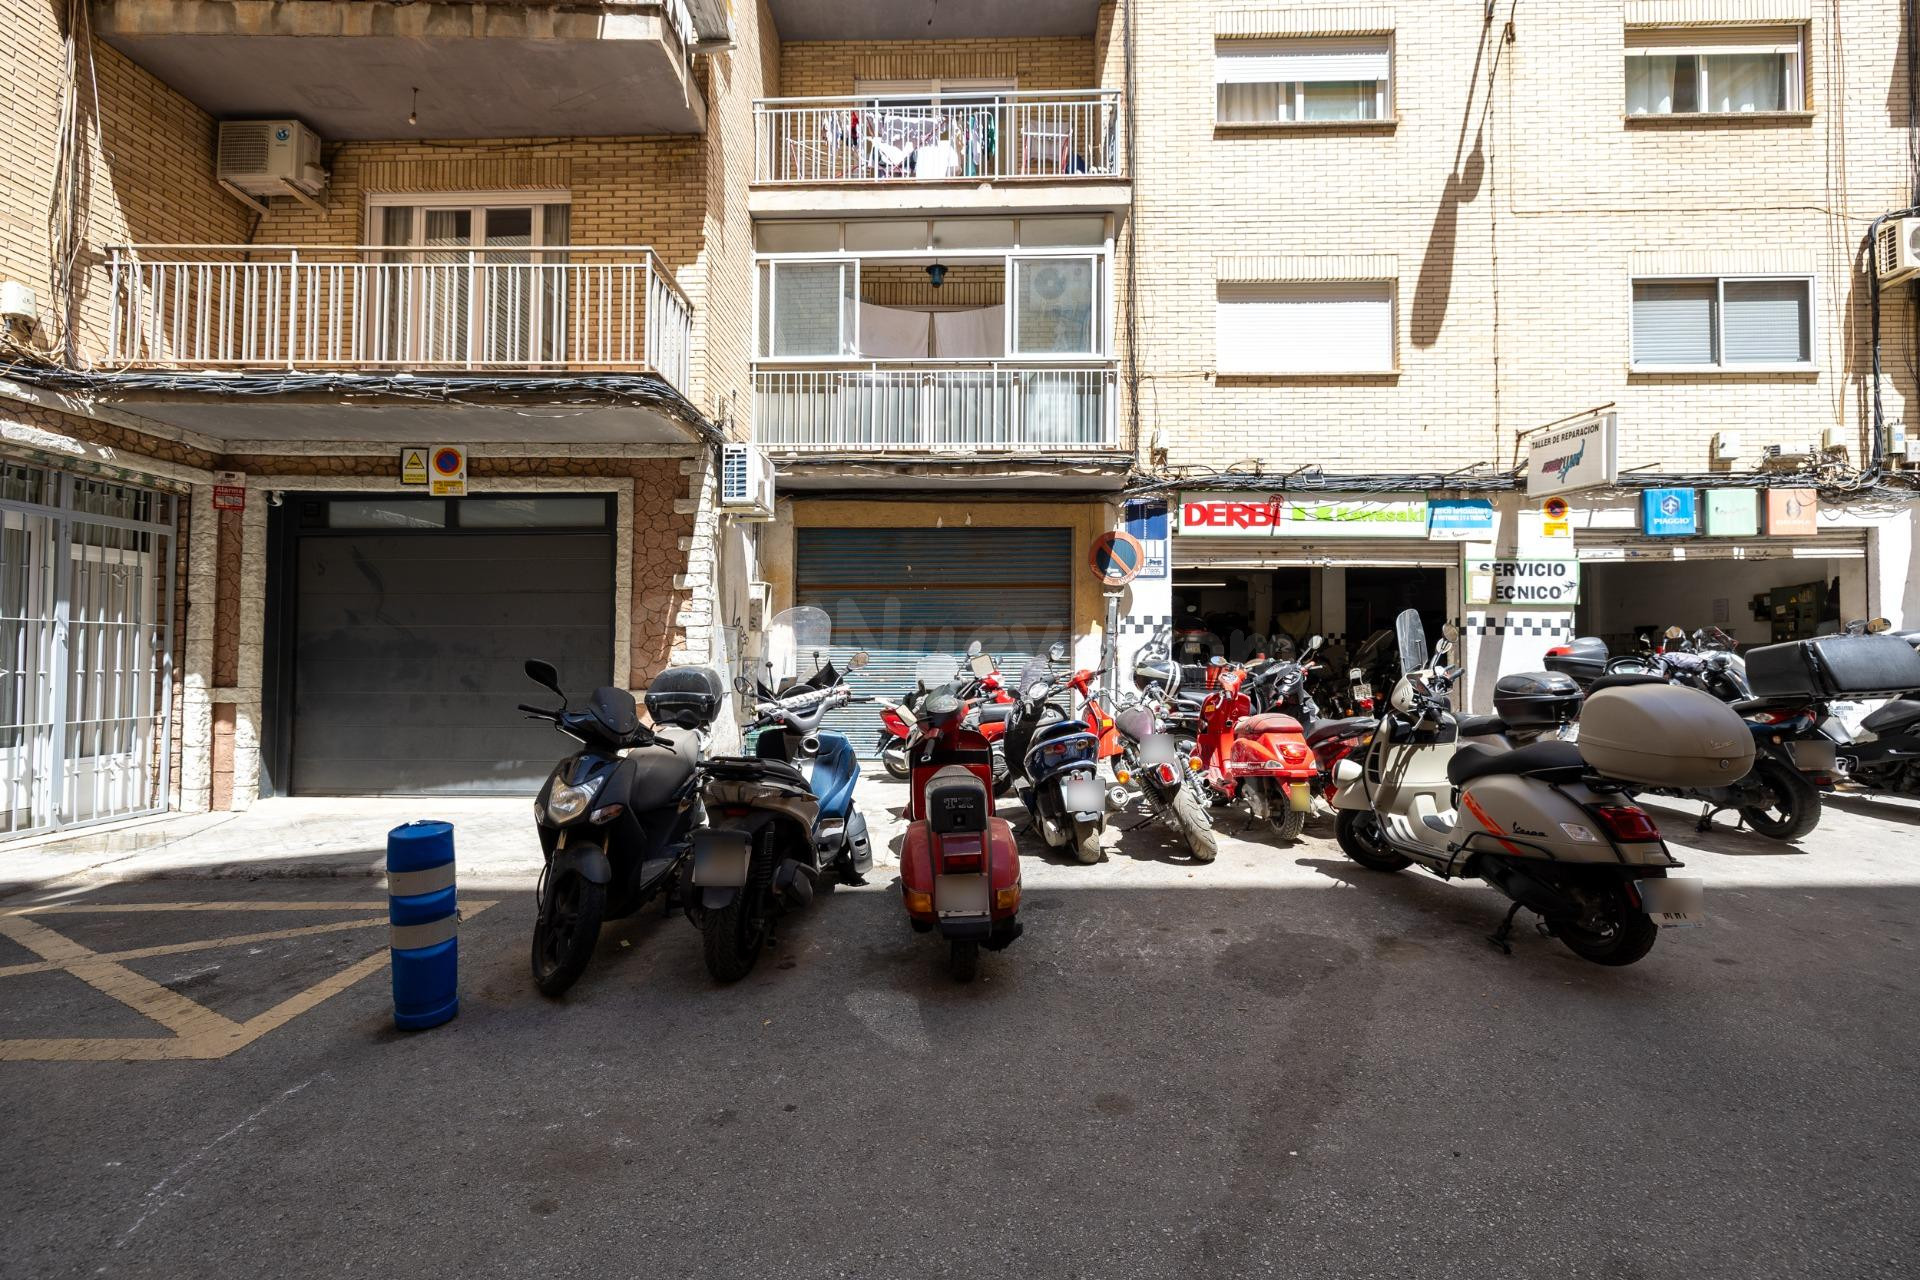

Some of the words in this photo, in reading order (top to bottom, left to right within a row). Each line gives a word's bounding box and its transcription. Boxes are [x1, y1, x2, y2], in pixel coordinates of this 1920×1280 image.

[1532, 437, 1552, 449] TALLER
[1552, 434, 1560, 444] DE
[1561, 423, 1600, 442] REPARACION
[1336, 507, 1425, 522] Kawasaki
[1653, 517, 1691, 525] PIAGGIO
[1479, 562, 1566, 577] SERVICIO
